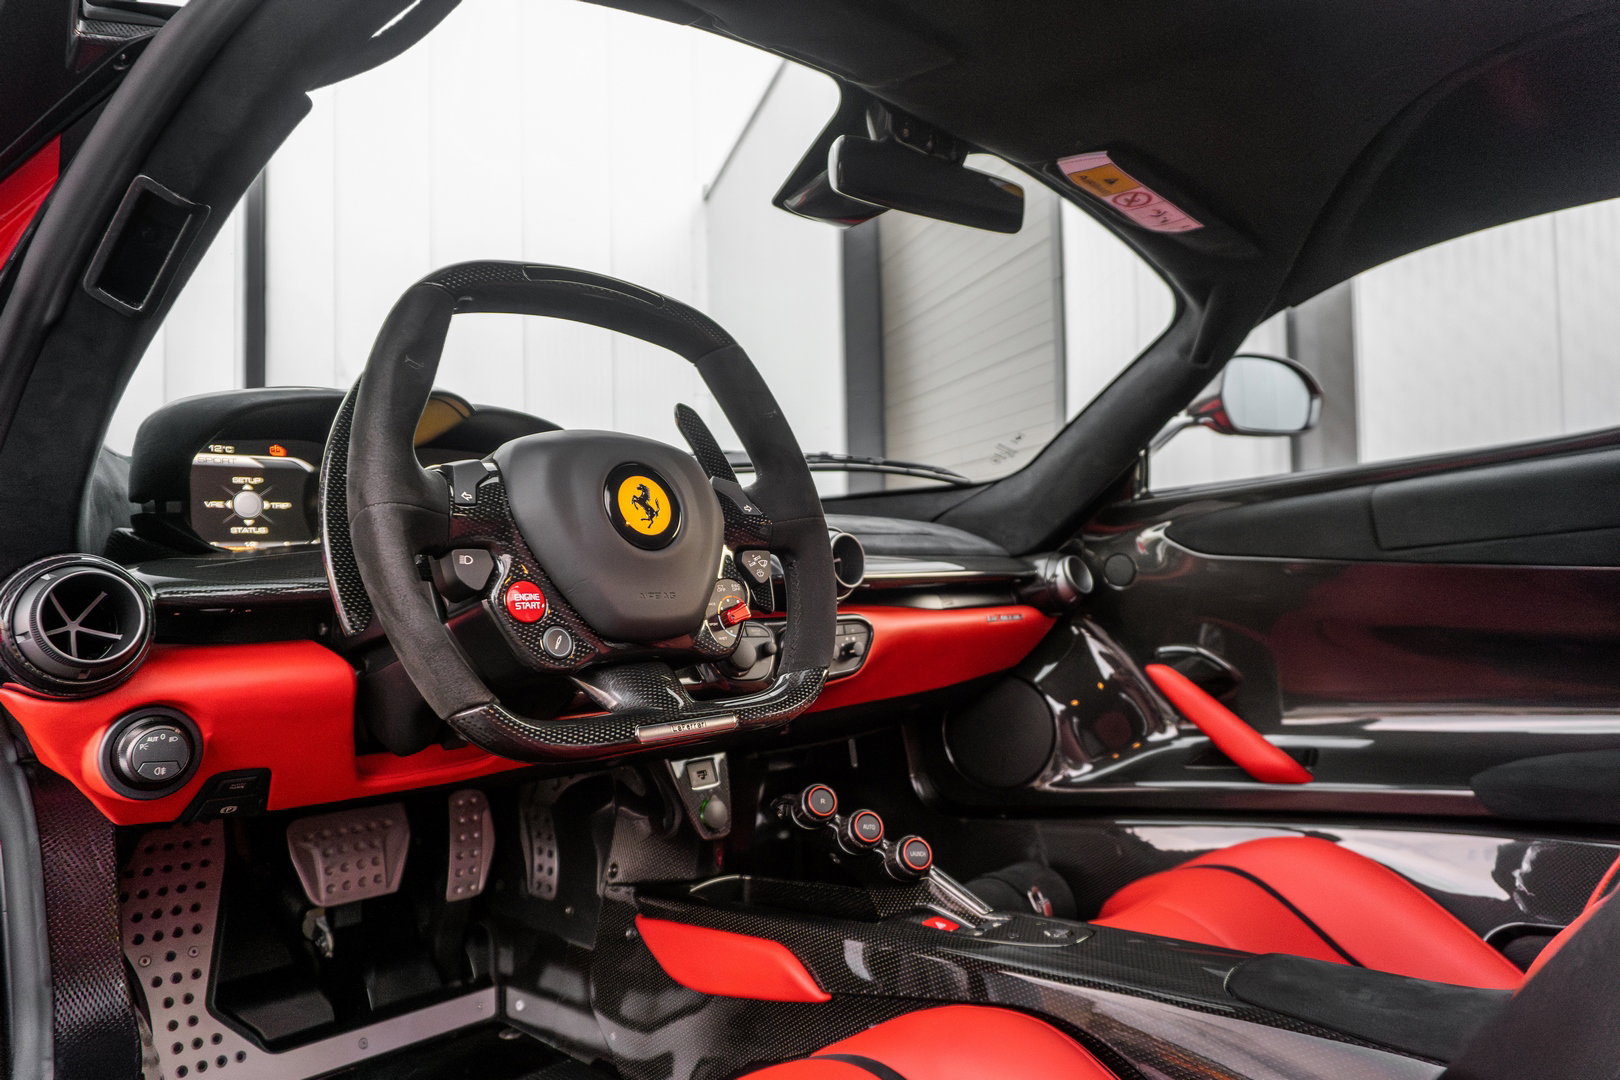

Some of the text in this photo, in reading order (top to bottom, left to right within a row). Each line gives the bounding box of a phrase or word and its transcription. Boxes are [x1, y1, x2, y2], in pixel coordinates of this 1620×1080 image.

[232, 476, 264, 484] SETUP
[230, 526, 269, 534] STATUS
[514, 593, 540, 601] ENGINE
[515, 601, 540, 610] START
